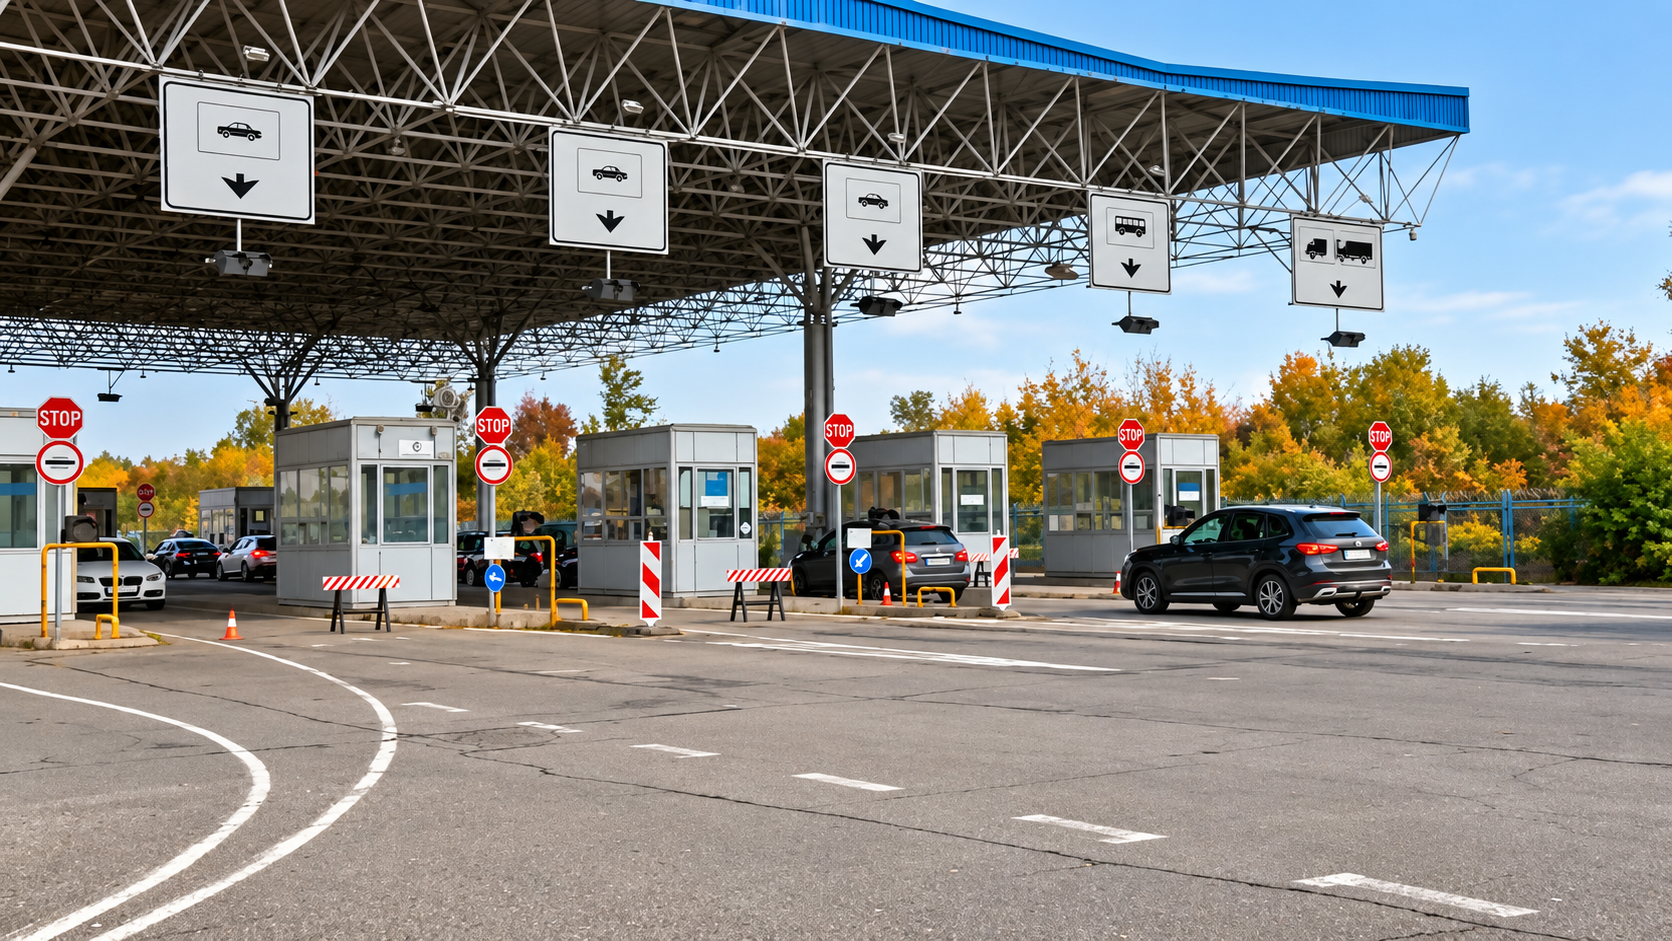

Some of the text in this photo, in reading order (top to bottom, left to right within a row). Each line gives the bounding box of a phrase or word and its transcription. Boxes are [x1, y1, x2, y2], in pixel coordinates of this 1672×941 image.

[39, 410, 81, 427] STOP
[478, 418, 510, 433] STOP
[825, 423, 853, 438] STOP
[1119, 428, 1142, 441] STOP
[1370, 430, 1391, 443] STOP
